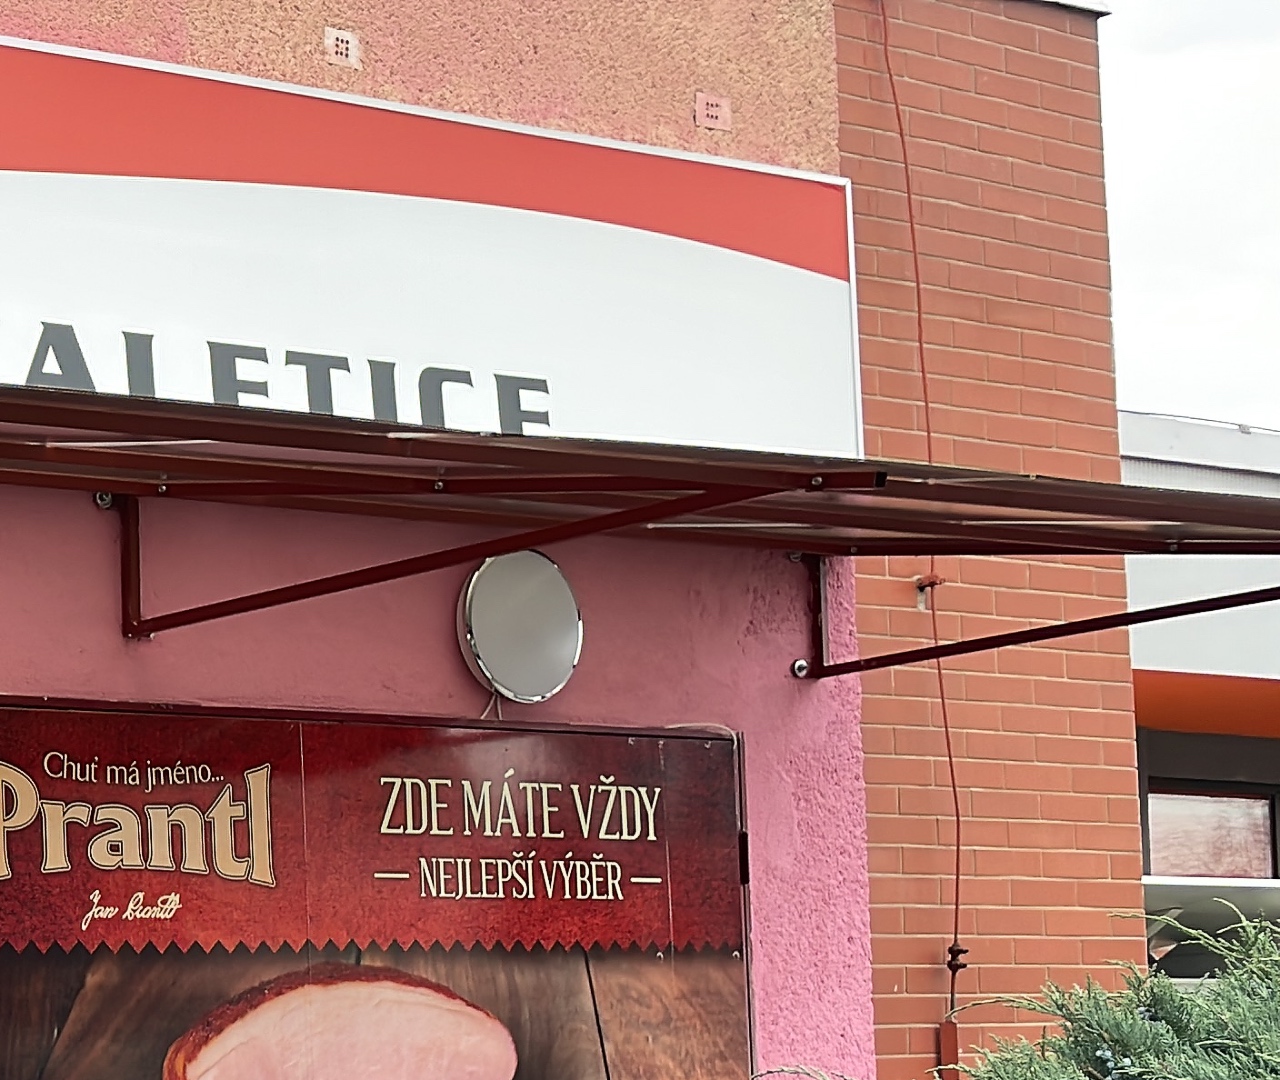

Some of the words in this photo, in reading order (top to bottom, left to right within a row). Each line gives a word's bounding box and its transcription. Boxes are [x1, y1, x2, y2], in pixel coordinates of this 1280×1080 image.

[43, 751, 98, 783] Chuť
[106, 762, 140, 786] má
[144, 761, 225, 793] jméno...
[380, 777, 454, 835] ZDE
[461, 767, 565, 838] MÁTE
[570, 774, 662, 841] VŽDY
[418, 850, 537, 900] NEJLEPŠÍ
[539, 851, 624, 901] VÝBĚR
